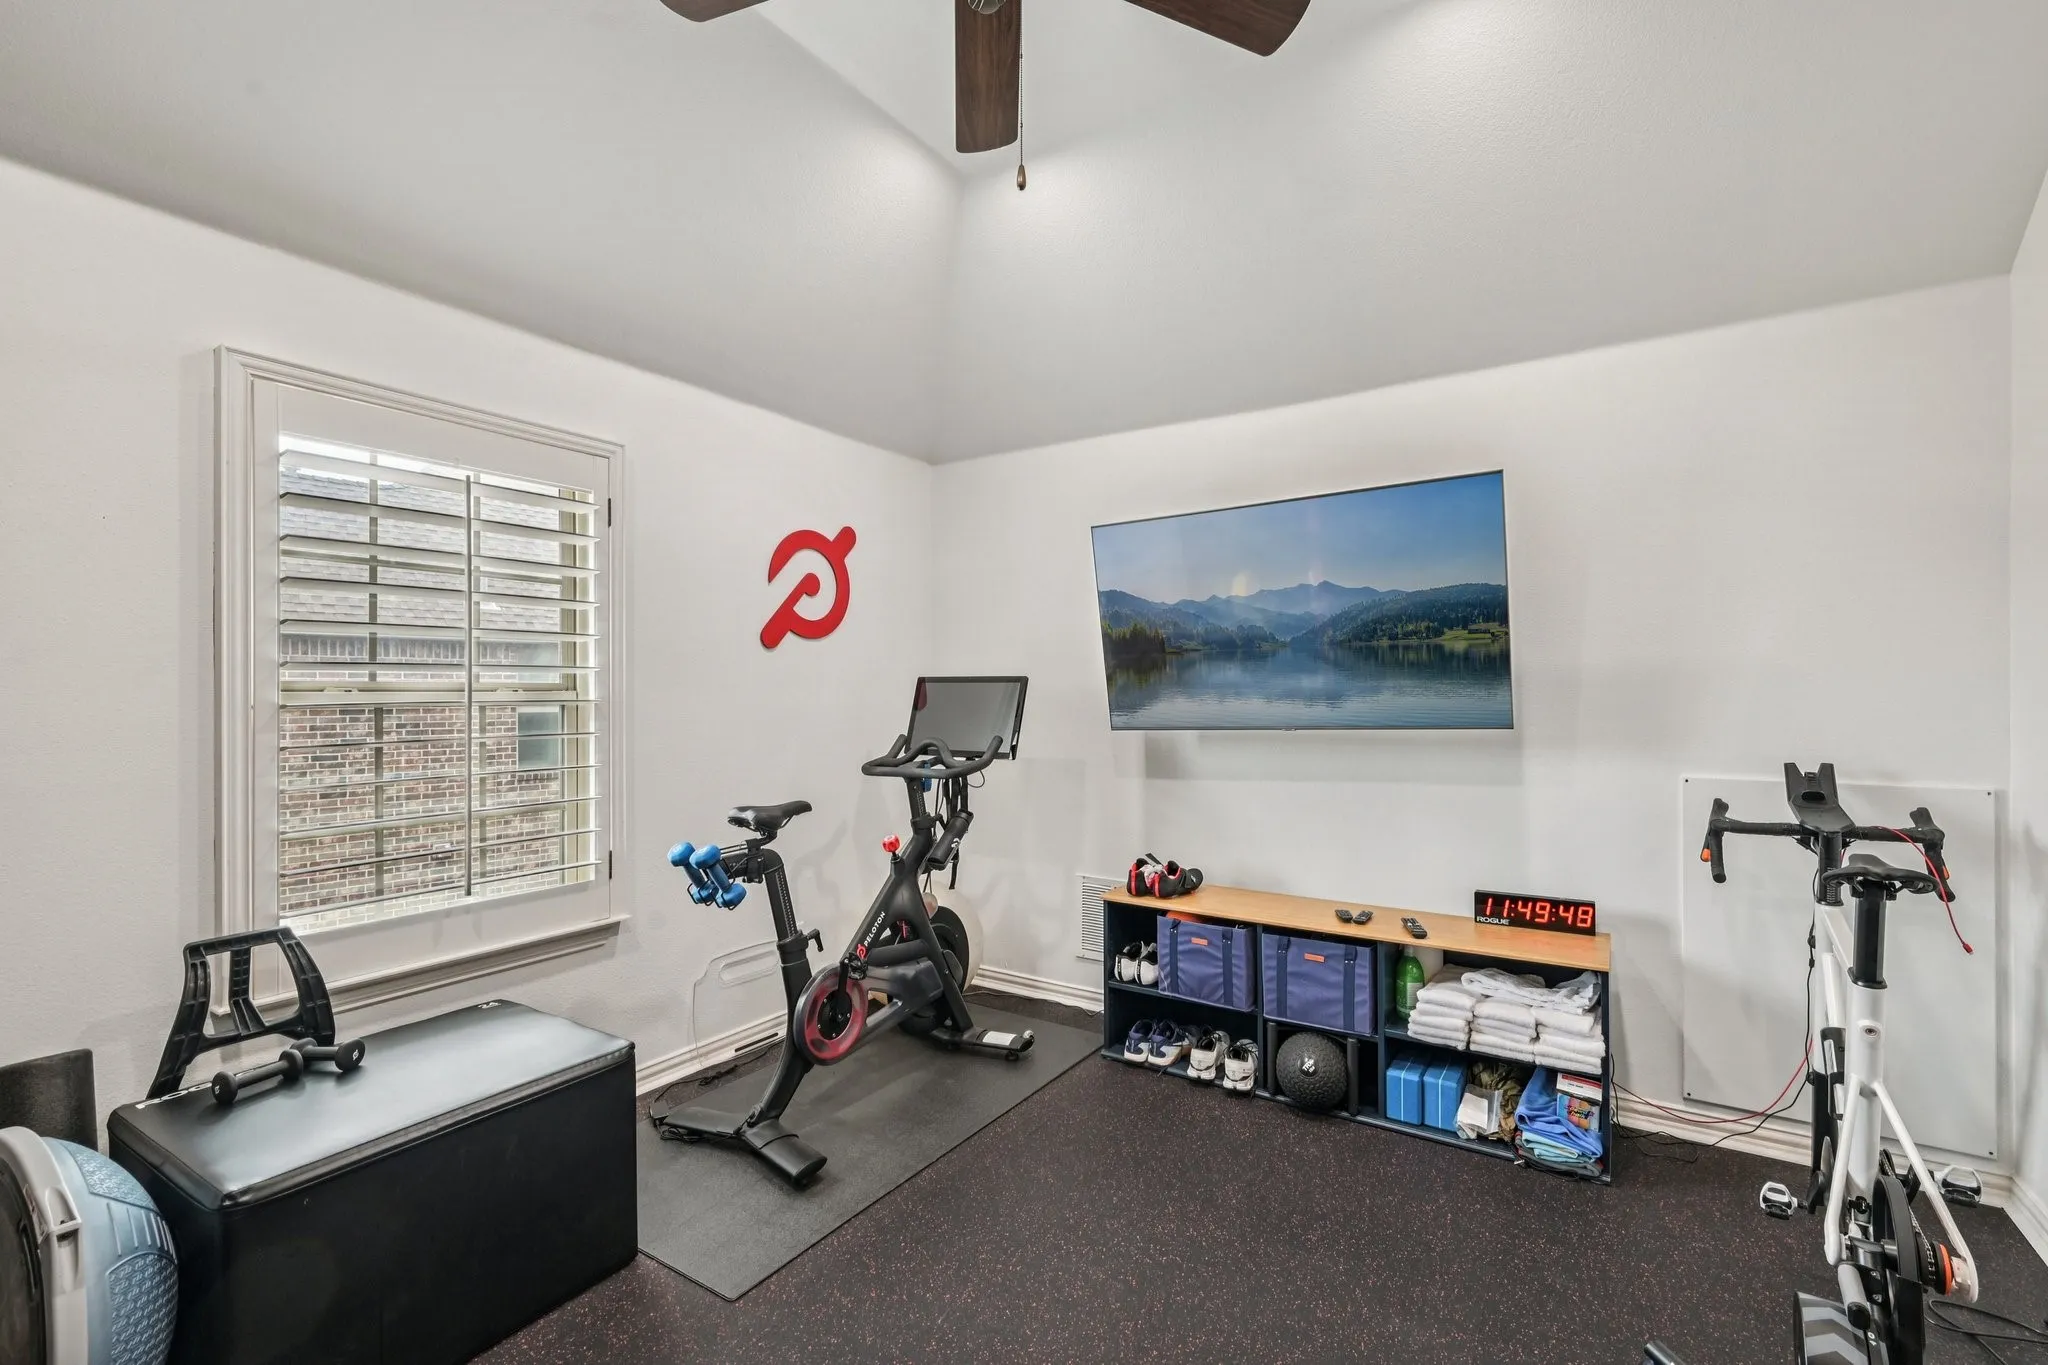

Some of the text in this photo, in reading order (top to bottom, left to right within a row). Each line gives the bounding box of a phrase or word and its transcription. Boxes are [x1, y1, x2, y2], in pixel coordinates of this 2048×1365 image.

[1476, 916, 1510, 926] ROGUE
[1486, 898, 1593, 928] 11:49:48
[863, 911, 886, 947] PELOTON
